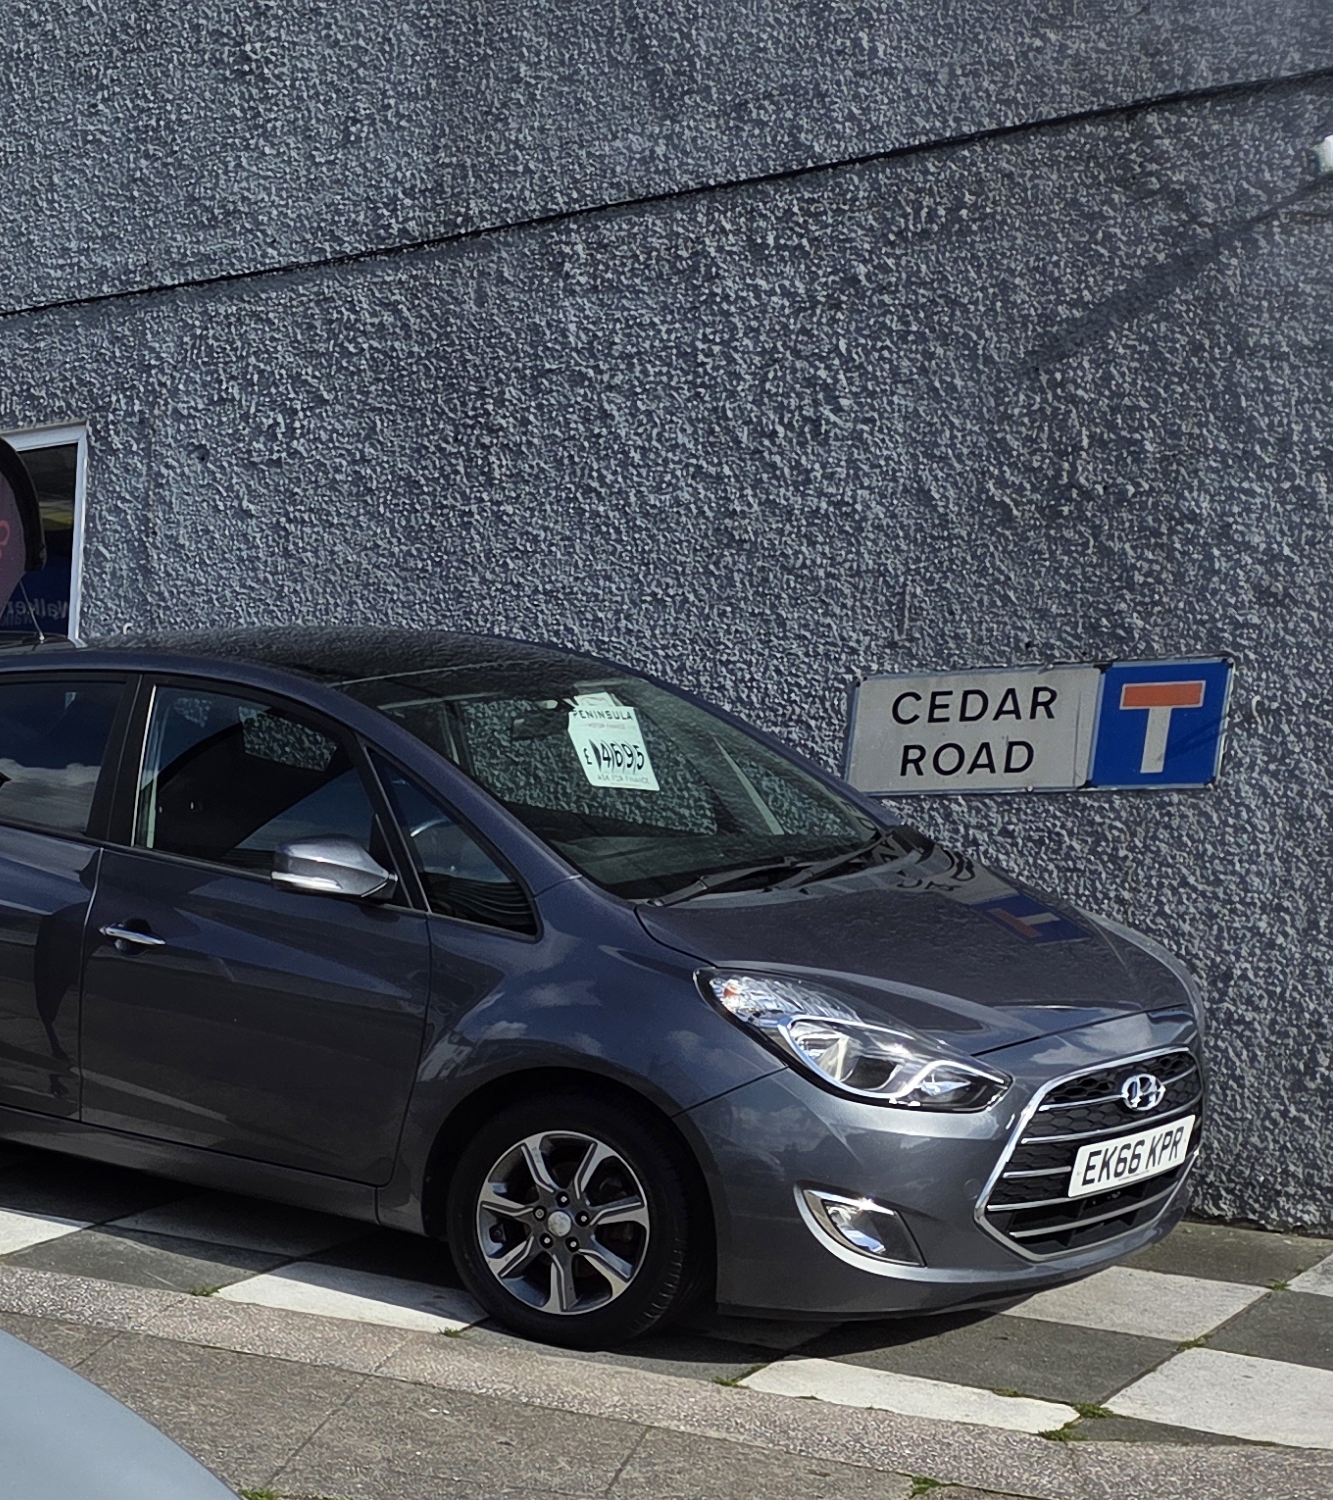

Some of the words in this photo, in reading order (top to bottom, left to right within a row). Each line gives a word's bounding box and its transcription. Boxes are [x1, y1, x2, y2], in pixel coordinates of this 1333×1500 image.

[573, 709, 633, 720] PENINSULA
[891, 686, 1058, 725] CEDAR
[900, 741, 1034, 776] ROAD
[1081, 1139, 1146, 1187] EK66
[1145, 1126, 1185, 1170] KPR
